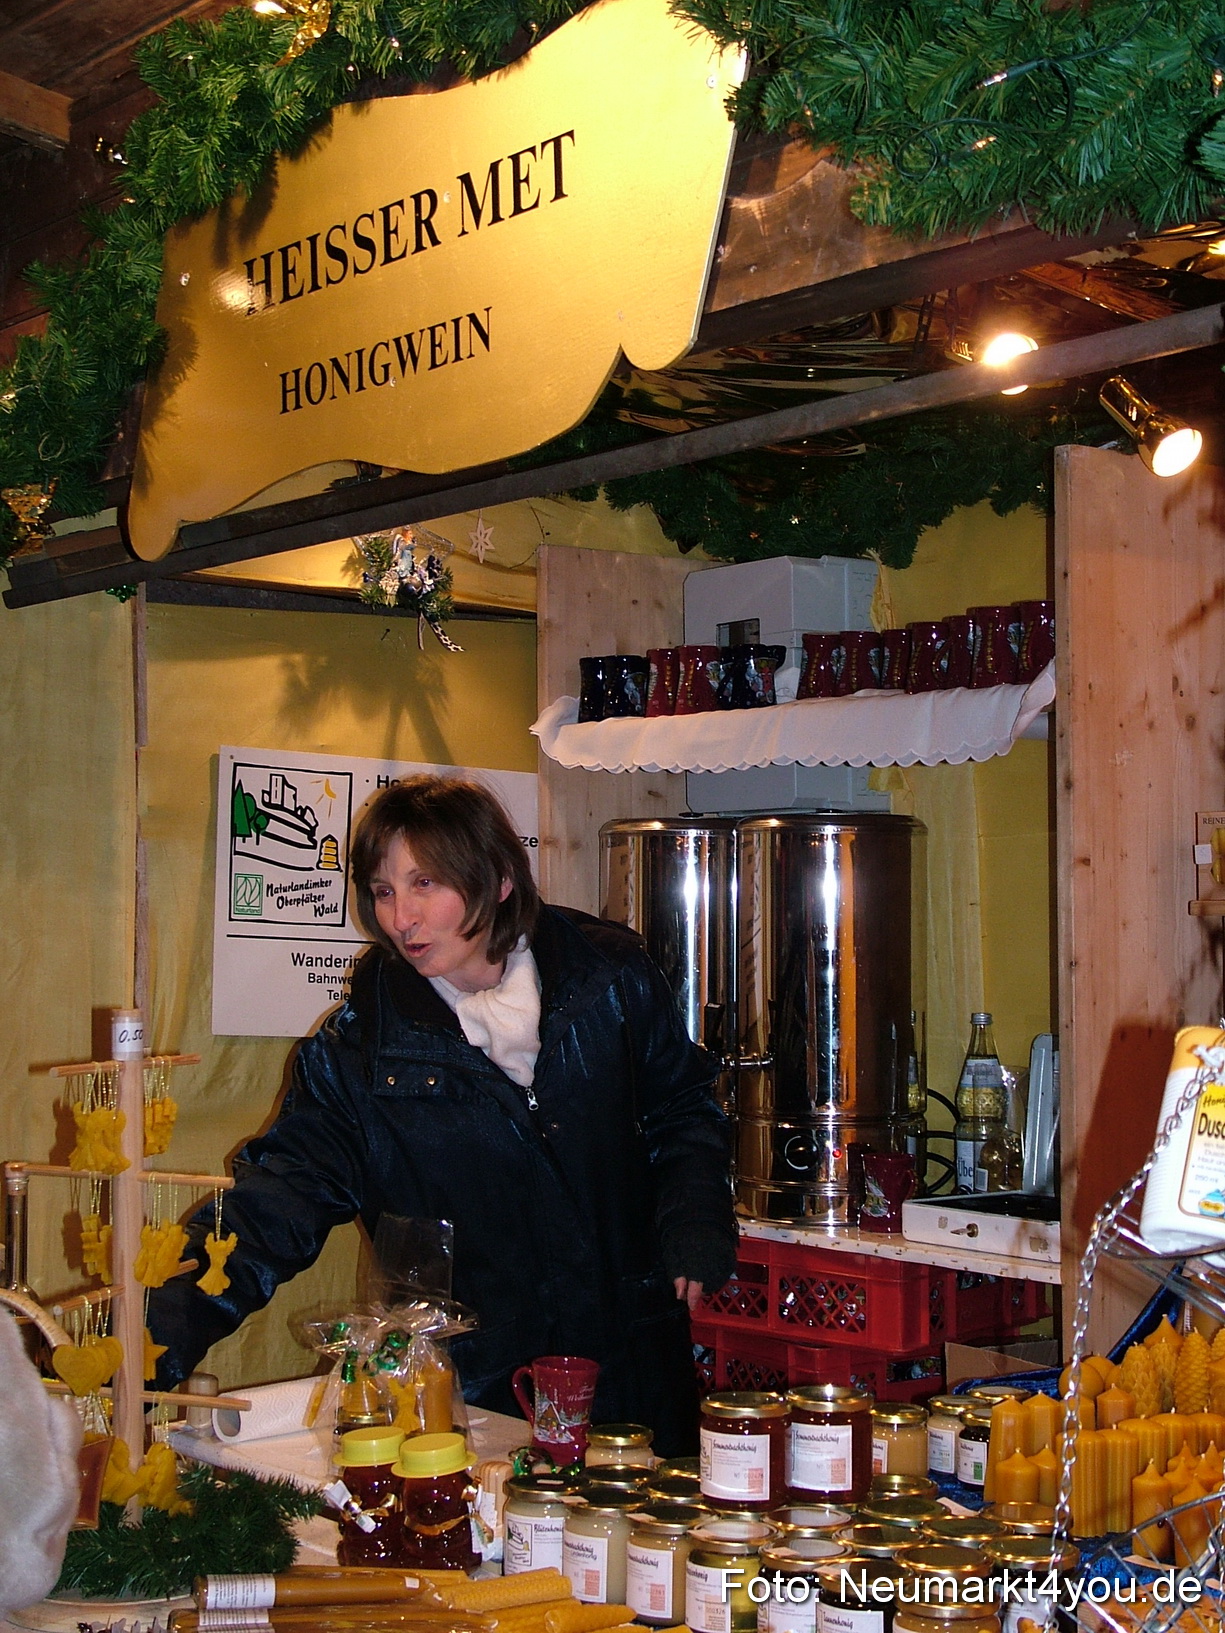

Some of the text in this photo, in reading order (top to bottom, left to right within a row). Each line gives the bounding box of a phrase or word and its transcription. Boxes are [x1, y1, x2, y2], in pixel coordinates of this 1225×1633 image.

[243, 128, 576, 317] HEISSER MET
[279, 305, 493, 416] HONIGWEIN
[266, 878, 333, 898] Naturlandimker
[276, 894, 326, 910] Oberpfälzer
[313, 902, 339, 918] Wald
